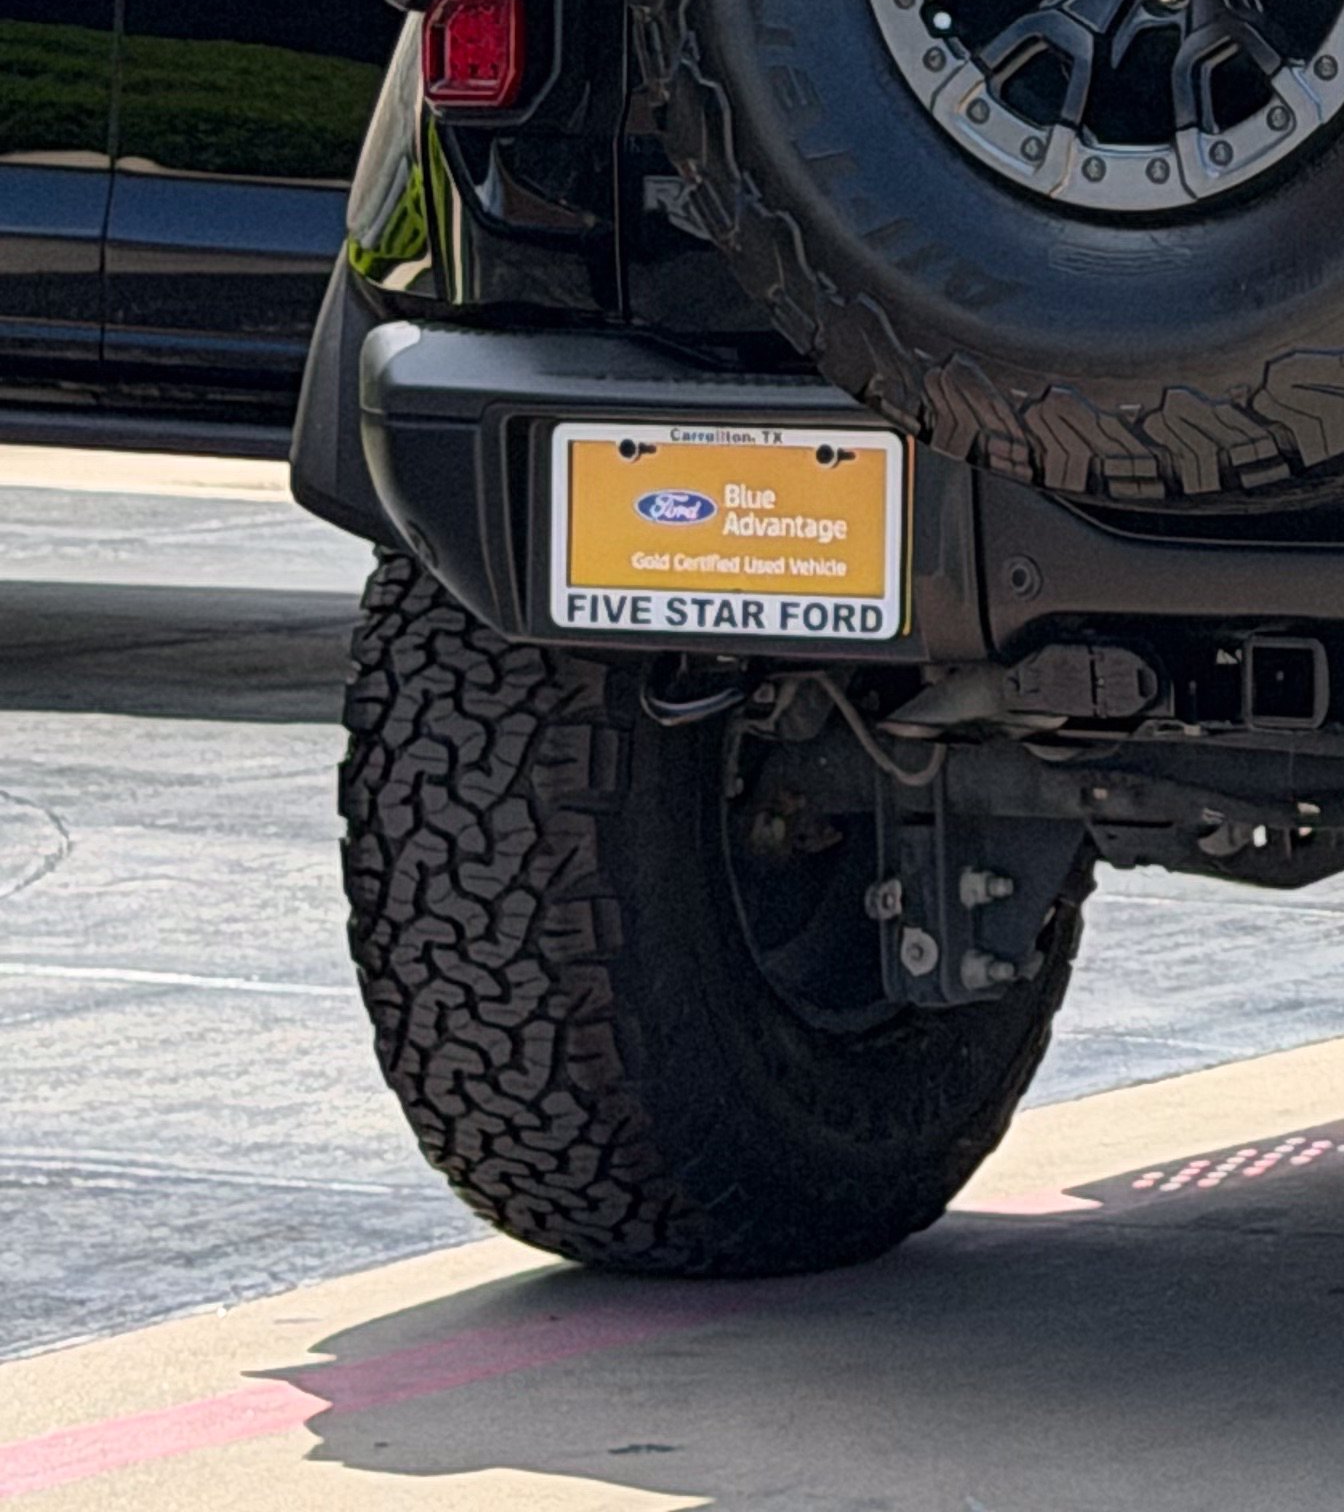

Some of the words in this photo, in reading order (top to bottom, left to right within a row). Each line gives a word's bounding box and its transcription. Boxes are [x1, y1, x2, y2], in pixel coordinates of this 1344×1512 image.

[761, 430, 784, 445] TX
[649, 492, 702, 522] Ford
[724, 483, 776, 509] Blue
[722, 512, 848, 544] Advantage
[631, 551, 670, 571] Gold
[673, 552, 740, 574] Certified
[743, 554, 785, 575] Used
[789, 556, 847, 577] Vehicle
[566, 594, 653, 625] FIVE
[665, 597, 766, 631] STAR
[779, 601, 883, 634] FORD
